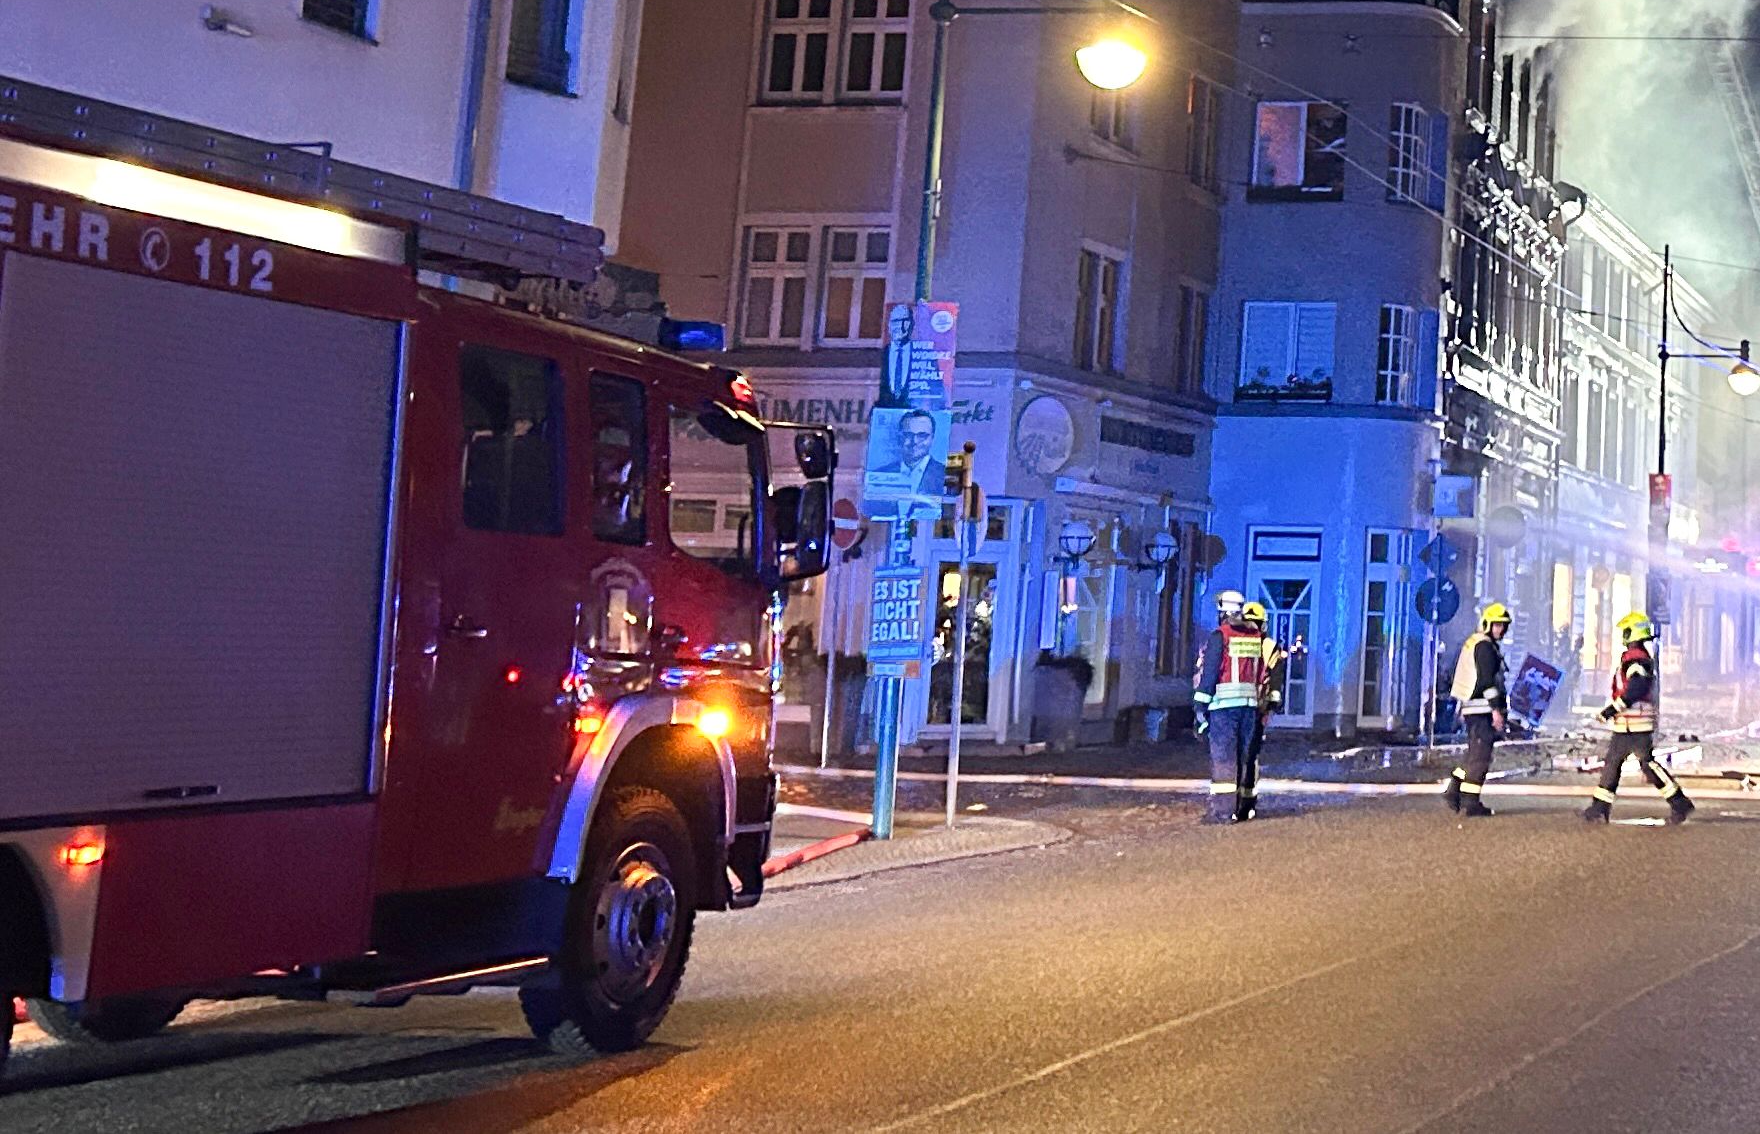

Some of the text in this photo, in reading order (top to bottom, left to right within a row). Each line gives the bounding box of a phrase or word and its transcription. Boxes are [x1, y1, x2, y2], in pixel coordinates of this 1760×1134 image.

[194, 237, 274, 292] 112
[874, 579, 921, 600] ES IST
[873, 599, 920, 621] NICHT
[872, 620, 919, 643] EGAL!
